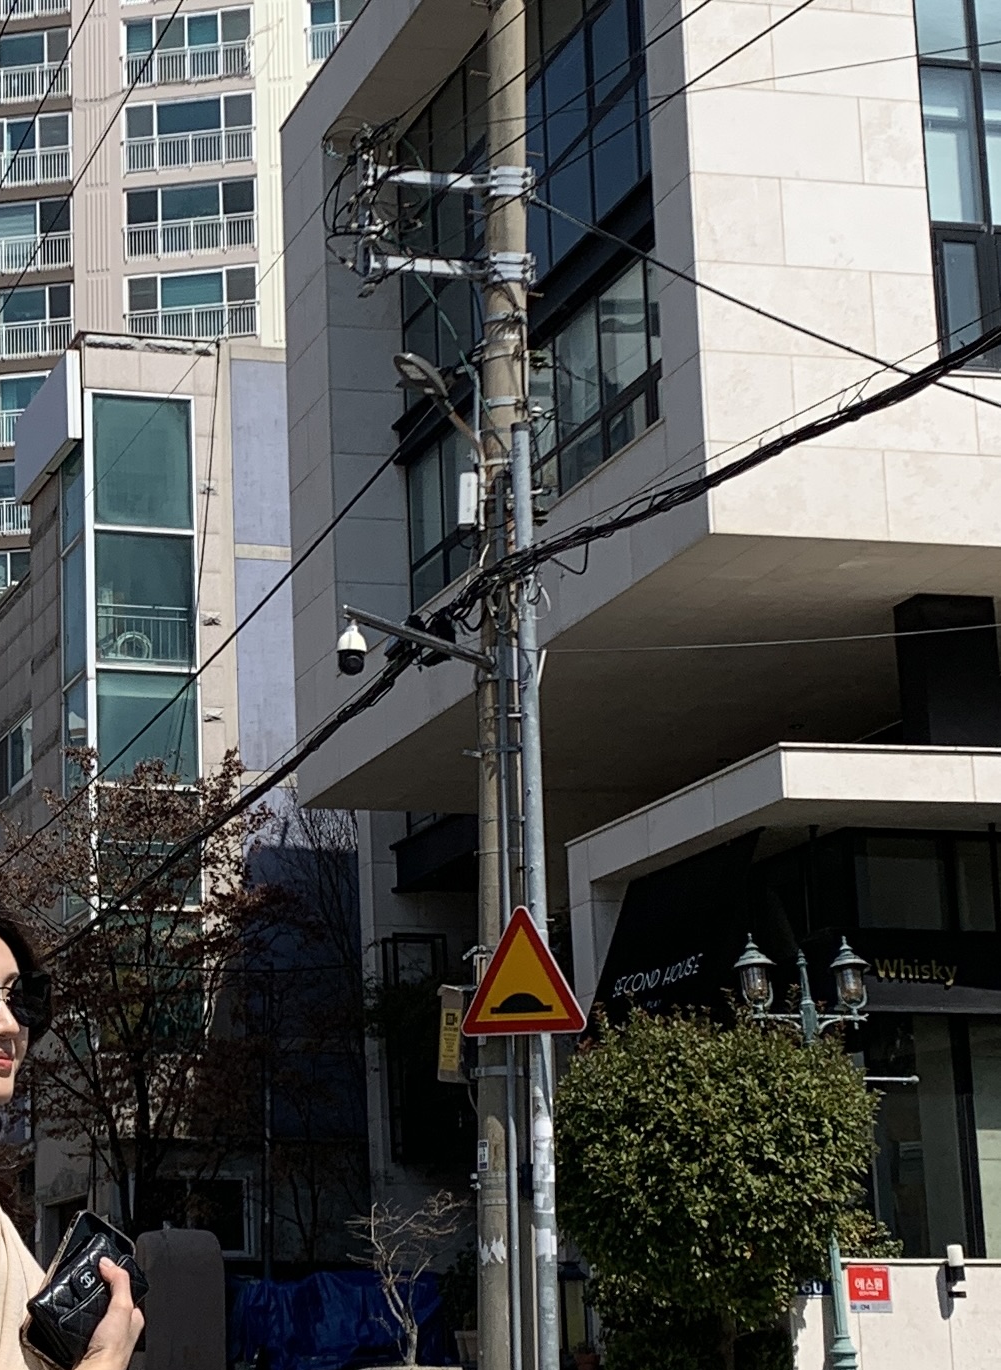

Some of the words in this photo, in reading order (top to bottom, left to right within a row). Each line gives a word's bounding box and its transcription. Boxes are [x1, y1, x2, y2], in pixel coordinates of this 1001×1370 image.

[612, 969, 661, 998] SECOND
[661, 953, 704, 986] HOUSE
[875, 958, 957, 986] Whisky
